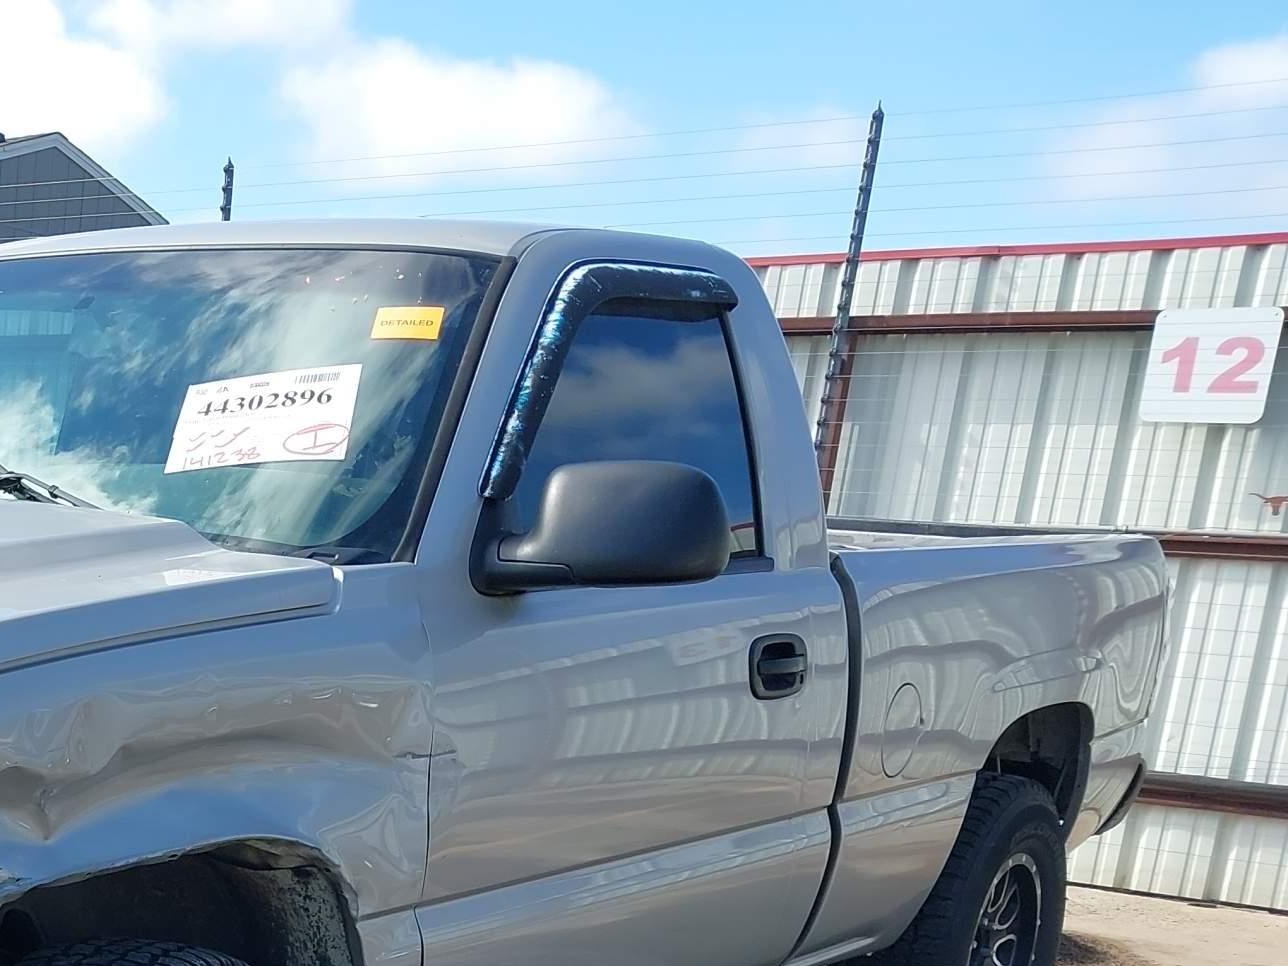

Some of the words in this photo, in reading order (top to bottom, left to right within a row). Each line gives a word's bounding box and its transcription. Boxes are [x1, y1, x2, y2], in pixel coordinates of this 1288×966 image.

[380, 319, 434, 327] DETAILED
[1160, 336, 1265, 394] 12
[197, 387, 333, 416] 44302896
